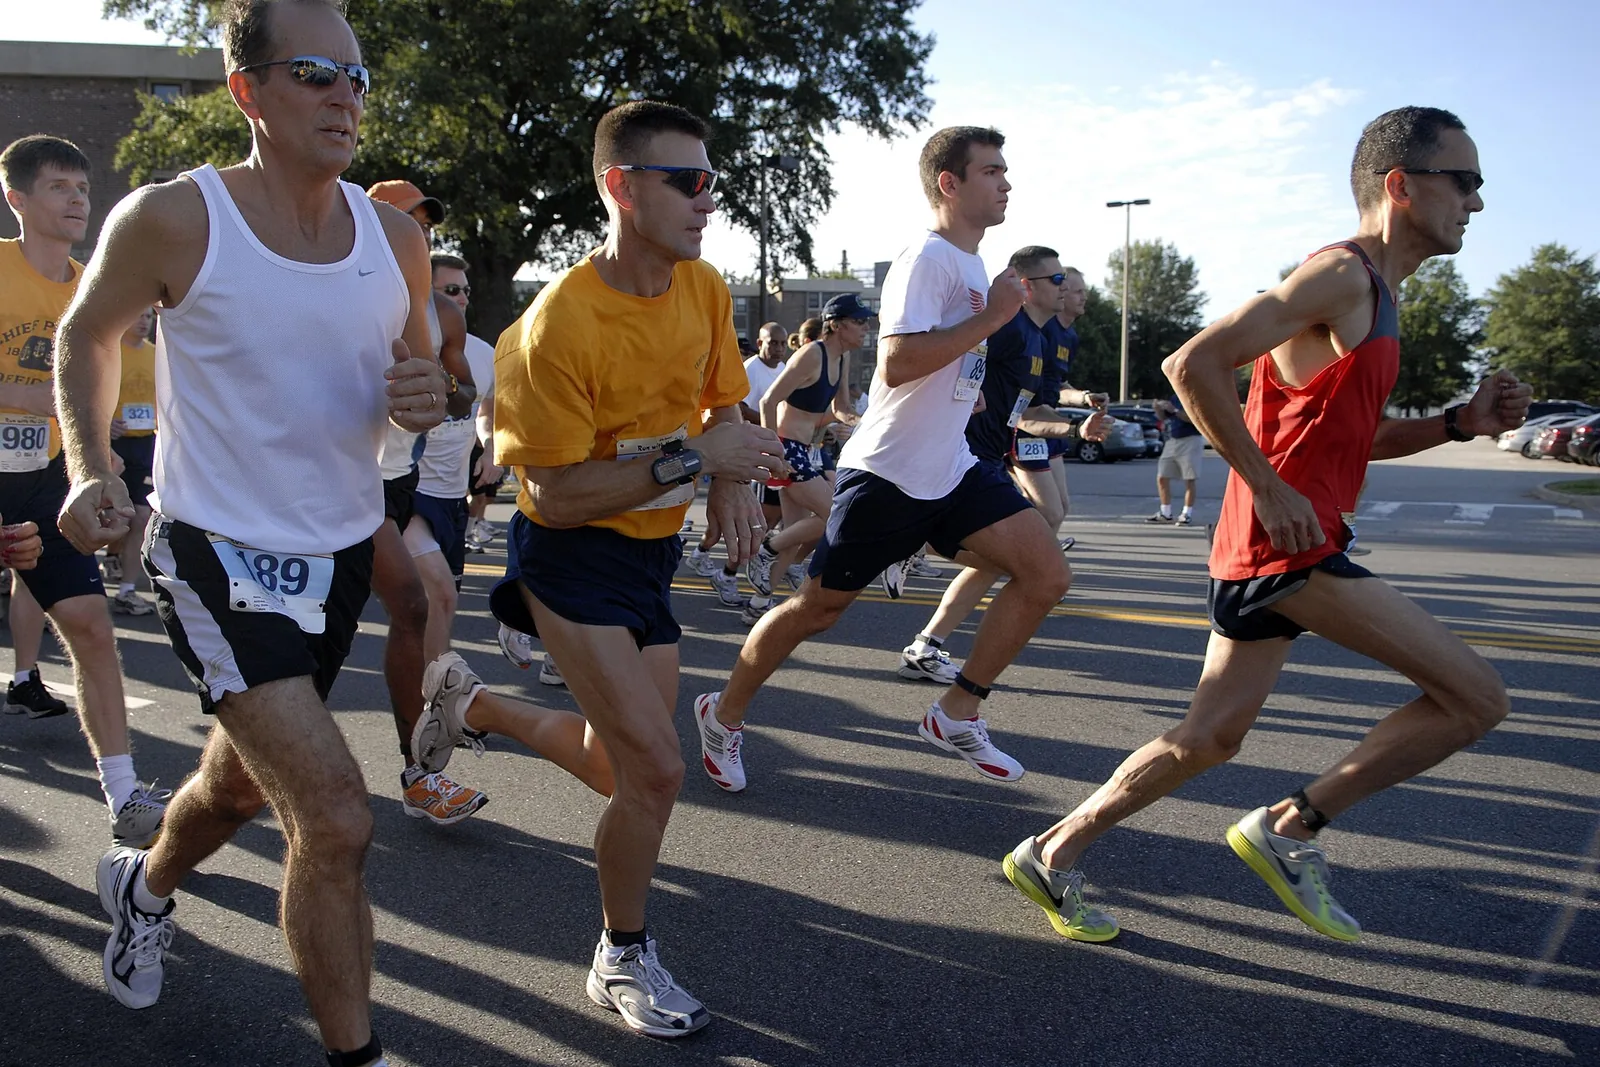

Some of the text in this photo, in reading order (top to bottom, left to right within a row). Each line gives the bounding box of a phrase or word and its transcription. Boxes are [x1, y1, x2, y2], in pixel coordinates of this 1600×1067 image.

[0, 320, 40, 344] HIEF
[128, 407, 150, 419] 321
[2, 426, 46, 450] 980
[1024, 443, 1045, 455] 281
